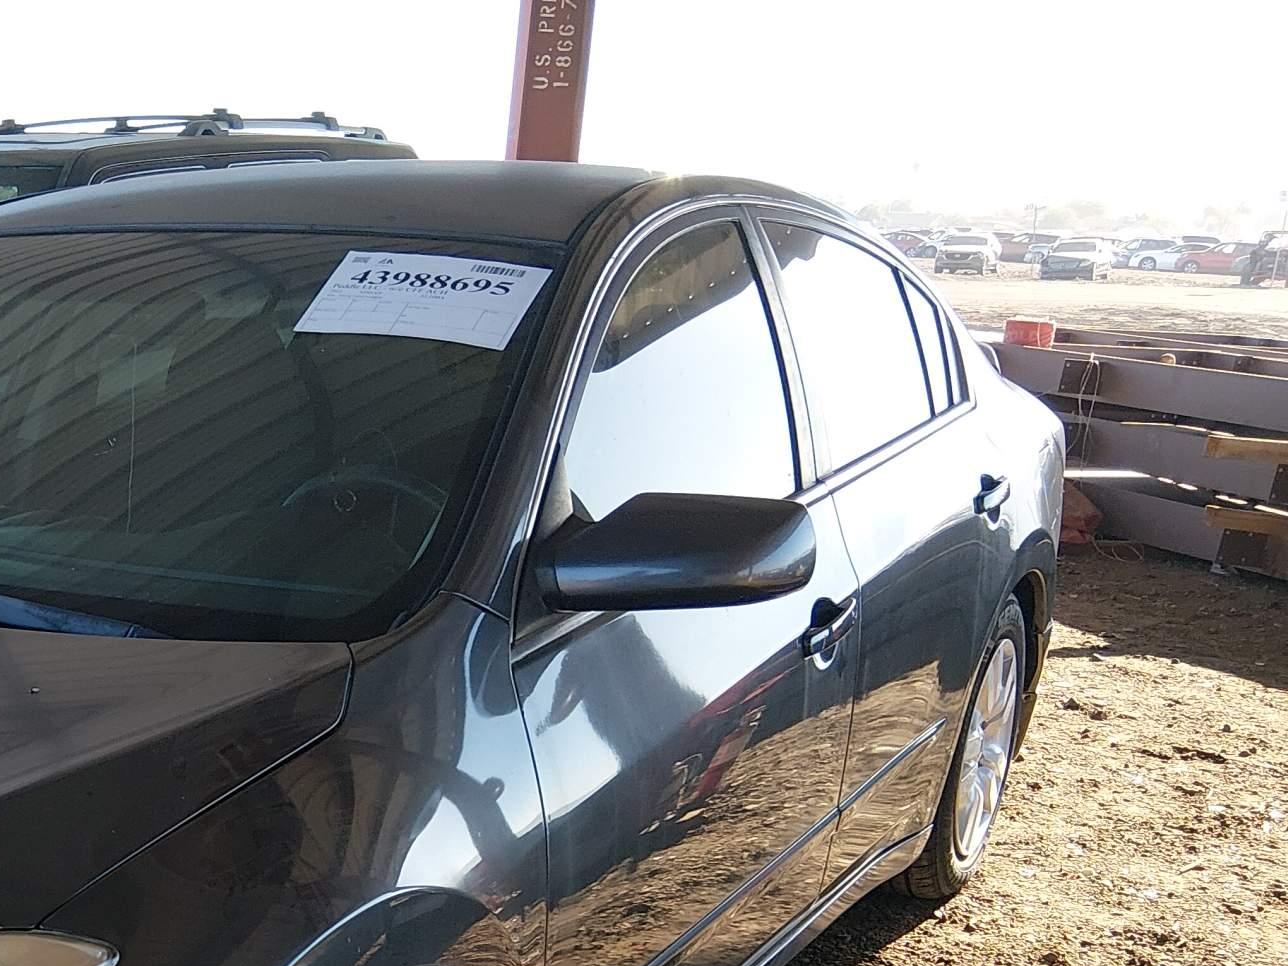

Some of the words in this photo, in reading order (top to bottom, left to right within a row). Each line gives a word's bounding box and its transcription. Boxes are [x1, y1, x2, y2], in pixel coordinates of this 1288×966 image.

[538, 0, 557, 33] PR
[532, 47, 553, 89] U.S.
[350, 269, 515, 296] 43988695
